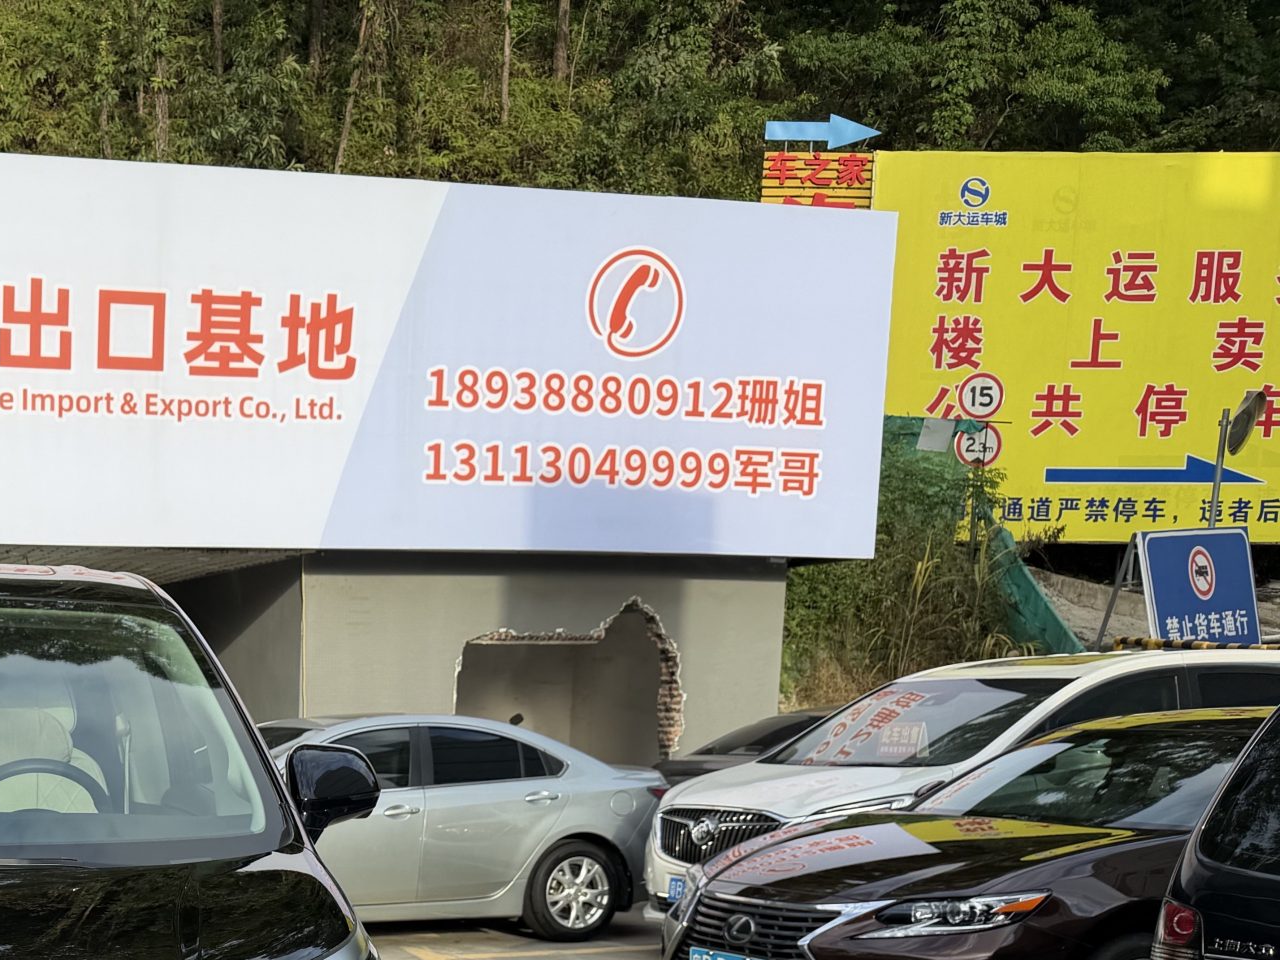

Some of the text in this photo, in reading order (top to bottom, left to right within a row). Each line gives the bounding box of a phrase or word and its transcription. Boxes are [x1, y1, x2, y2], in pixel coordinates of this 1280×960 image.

[765, 151, 869, 187] 车之家
[939, 211, 1008, 227] 新大运车城
[935, 248, 1280, 304] 新大运服
[22, 388, 113, 417] Import
[120, 391, 138, 415] &
[145, 393, 232, 422] Export
[239, 396, 287, 422] Co.,
[294, 397, 343, 421] Ltd.
[427, 368, 824, 427] 18938880912珊姐
[970, 386, 993, 407] 15
[425, 442, 821, 497] 13113049999军哥
[1166, 609, 1248, 640] 禁止货车通行
